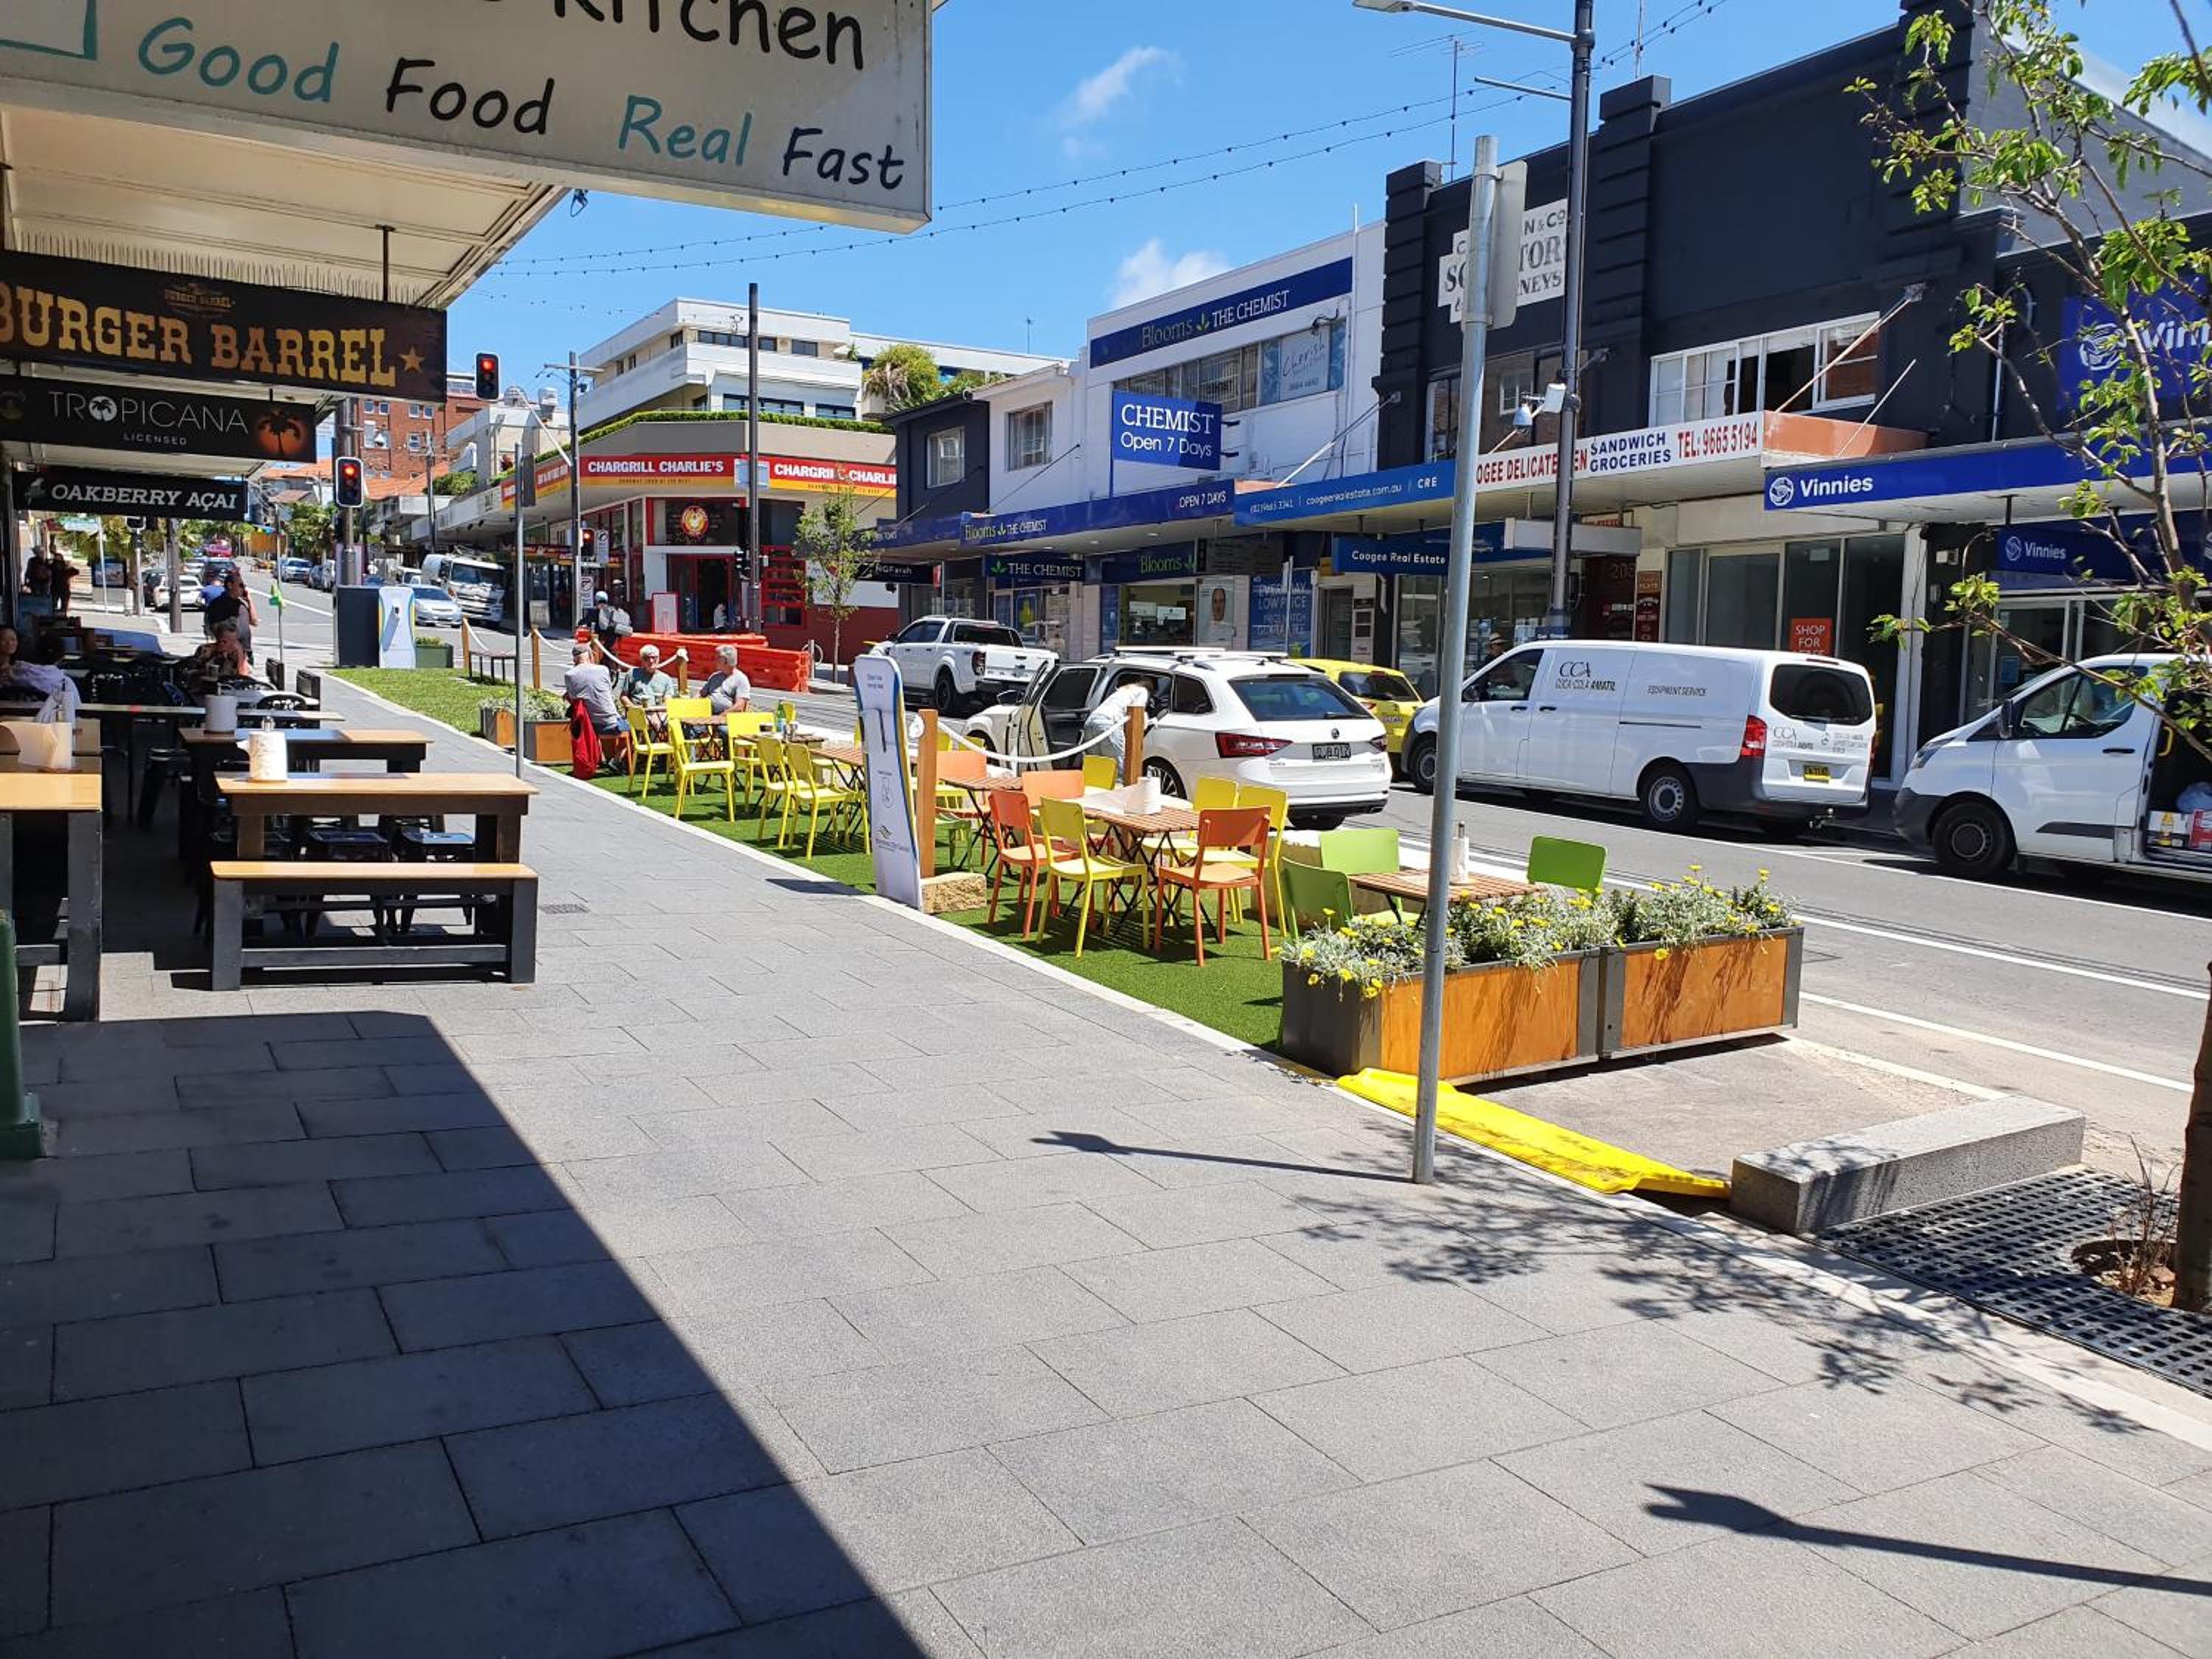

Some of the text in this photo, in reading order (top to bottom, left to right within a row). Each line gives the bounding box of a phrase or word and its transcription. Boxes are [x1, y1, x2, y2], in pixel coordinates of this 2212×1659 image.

[138, 16, 904, 190] Good Food Real Fast
[1142, 290, 1290, 347] Blooms THE CHEMIST
[211, 324, 396, 387] BARREL
[48, 391, 248, 434] TROPICANA
[1121, 403, 1214, 434] CHEMIST
[122, 432, 187, 445] LICENSED
[1121, 431, 1212, 459] Open 7 Days
[1590, 432, 1666, 456] SANDWICH
[1703, 426, 1728, 454] 9665
[1731, 421, 1758, 453] 5194
[588, 460, 724, 473] CHARGRILL CHARLIE'S
[1476, 448, 1588, 484] OGEE DELICATEEN
[1590, 449, 1672, 473] GROCERIES
[1417, 476, 1438, 489] CRE
[1800, 475, 1874, 497] Vinnies
[51, 484, 238, 512] OAKBERRY AÇAI
[1180, 490, 1227, 508] OPEN 7 DAYS
[965, 519, 1048, 540] Blooms THE CHEMIST
[1352, 550, 1447, 565] Coogee Real Estate
[2024, 540, 2067, 560] Vinnies
[1008, 563, 1083, 578] THE CHEMIST
[1140, 554, 1181, 574] Blooms
[1795, 625, 1826, 635] SHOP
[1798, 636, 1820, 647] FOR
[1559, 661, 1591, 678] CCA
